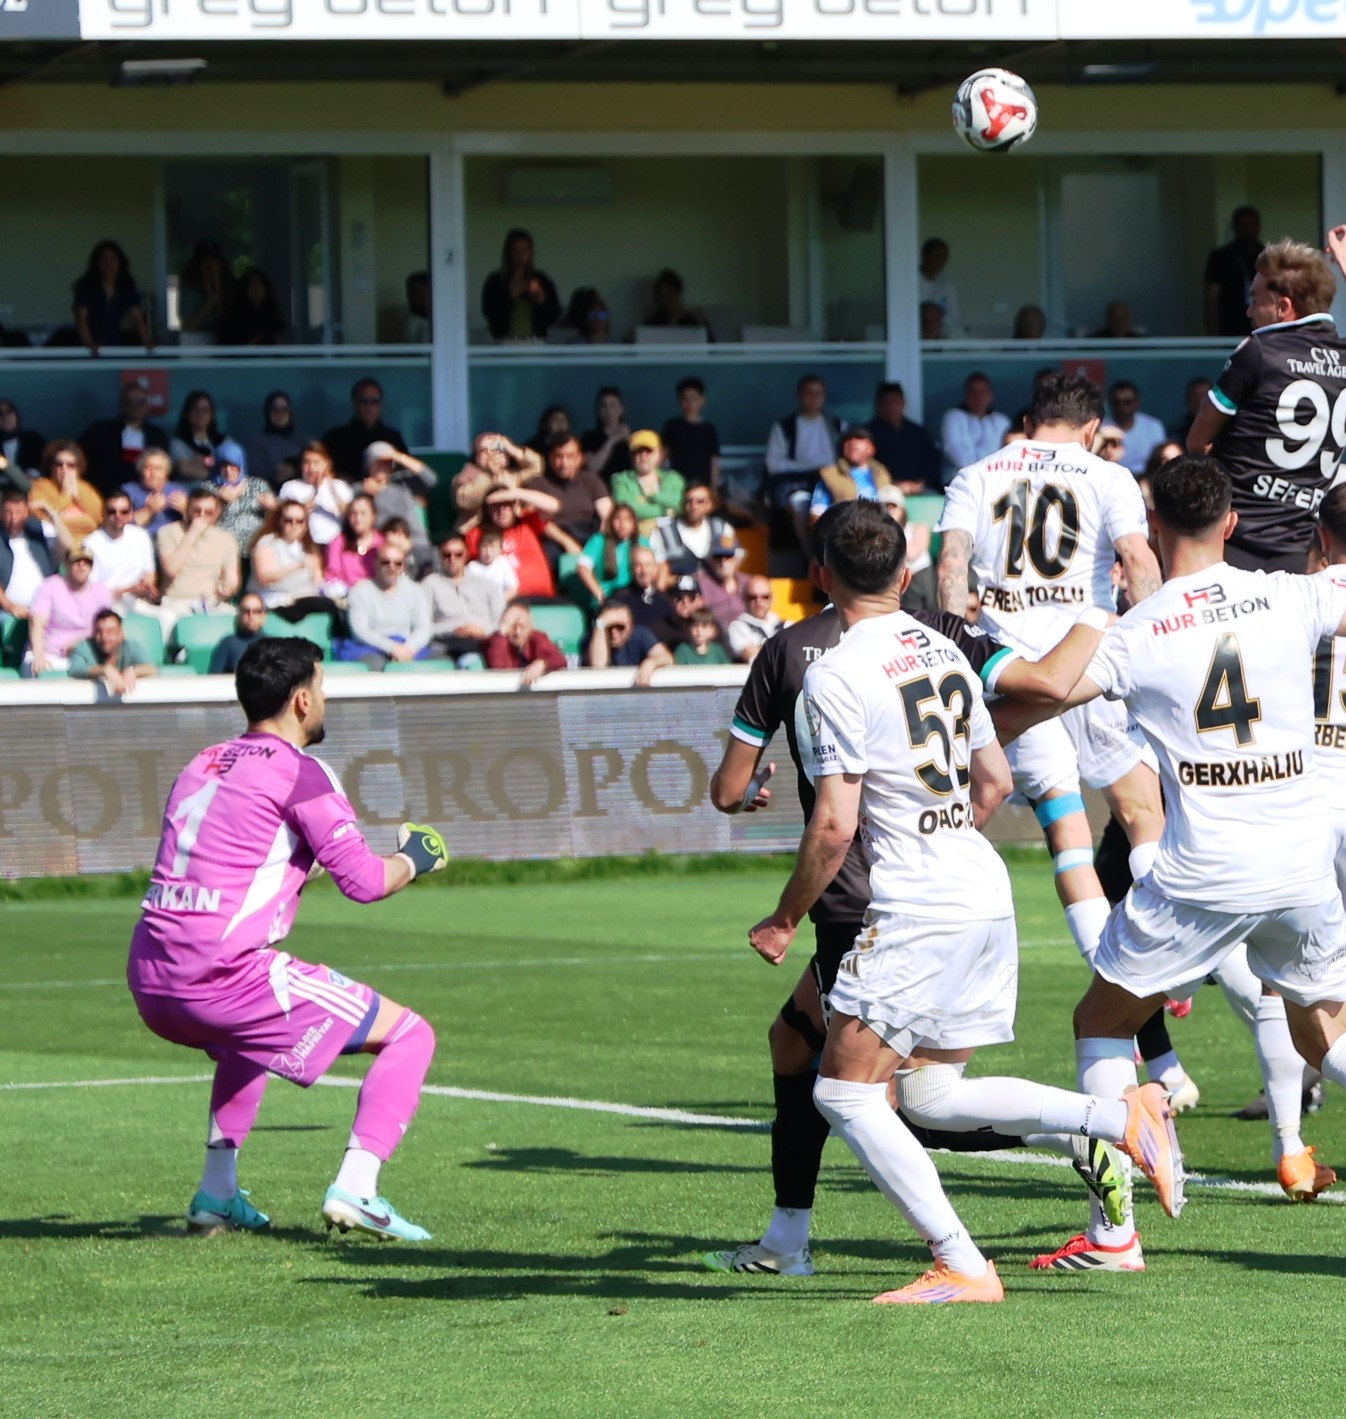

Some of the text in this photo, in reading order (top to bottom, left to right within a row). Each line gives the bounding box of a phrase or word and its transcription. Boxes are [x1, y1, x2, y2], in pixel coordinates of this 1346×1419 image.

[1287, 358, 1326, 375] TRAVEL
[1311, 347, 1341, 365] CIP
[1028, 462, 1088, 475] BETON
[991, 479, 1080, 580] 10
[981, 585, 1084, 612] EREN TOZLU
[1201, 597, 1271, 625] BETON
[1194, 632, 1262, 748] 4
[895, 669, 975, 797] 53
[1178, 750, 1304, 786] GERXHALIU
[173, 778, 220, 878] 1
